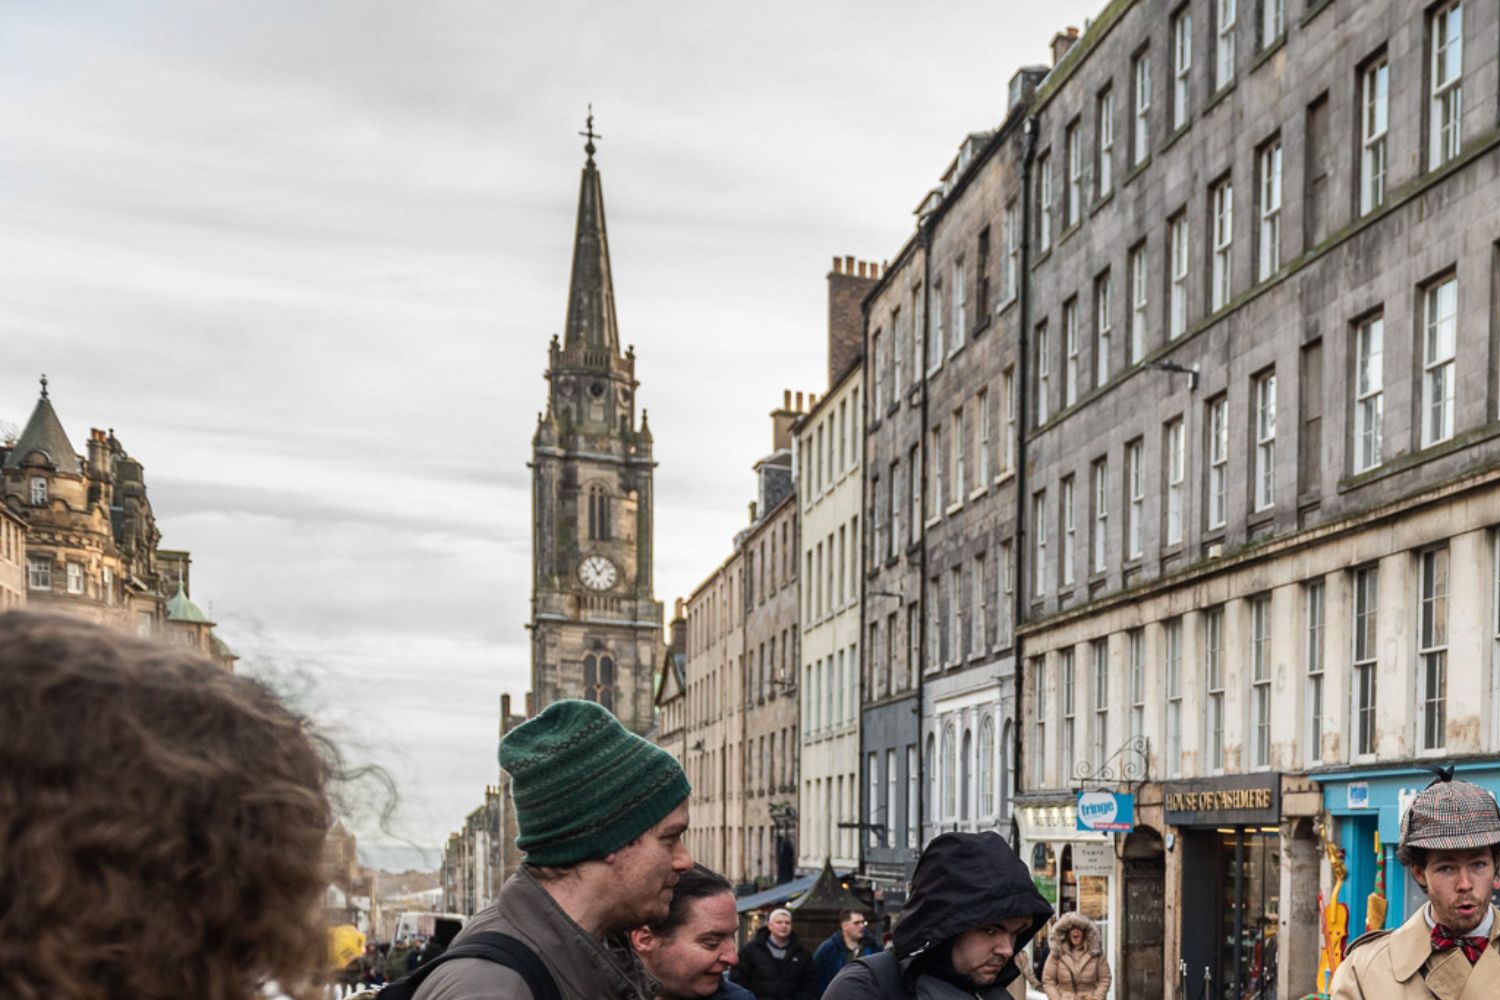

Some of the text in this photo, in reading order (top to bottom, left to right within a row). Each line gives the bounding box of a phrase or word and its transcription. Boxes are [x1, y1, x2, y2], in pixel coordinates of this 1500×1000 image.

[1081, 800, 1114, 817] fringe
[1166, 787, 1272, 811] HOUSE OF CASHMERE
